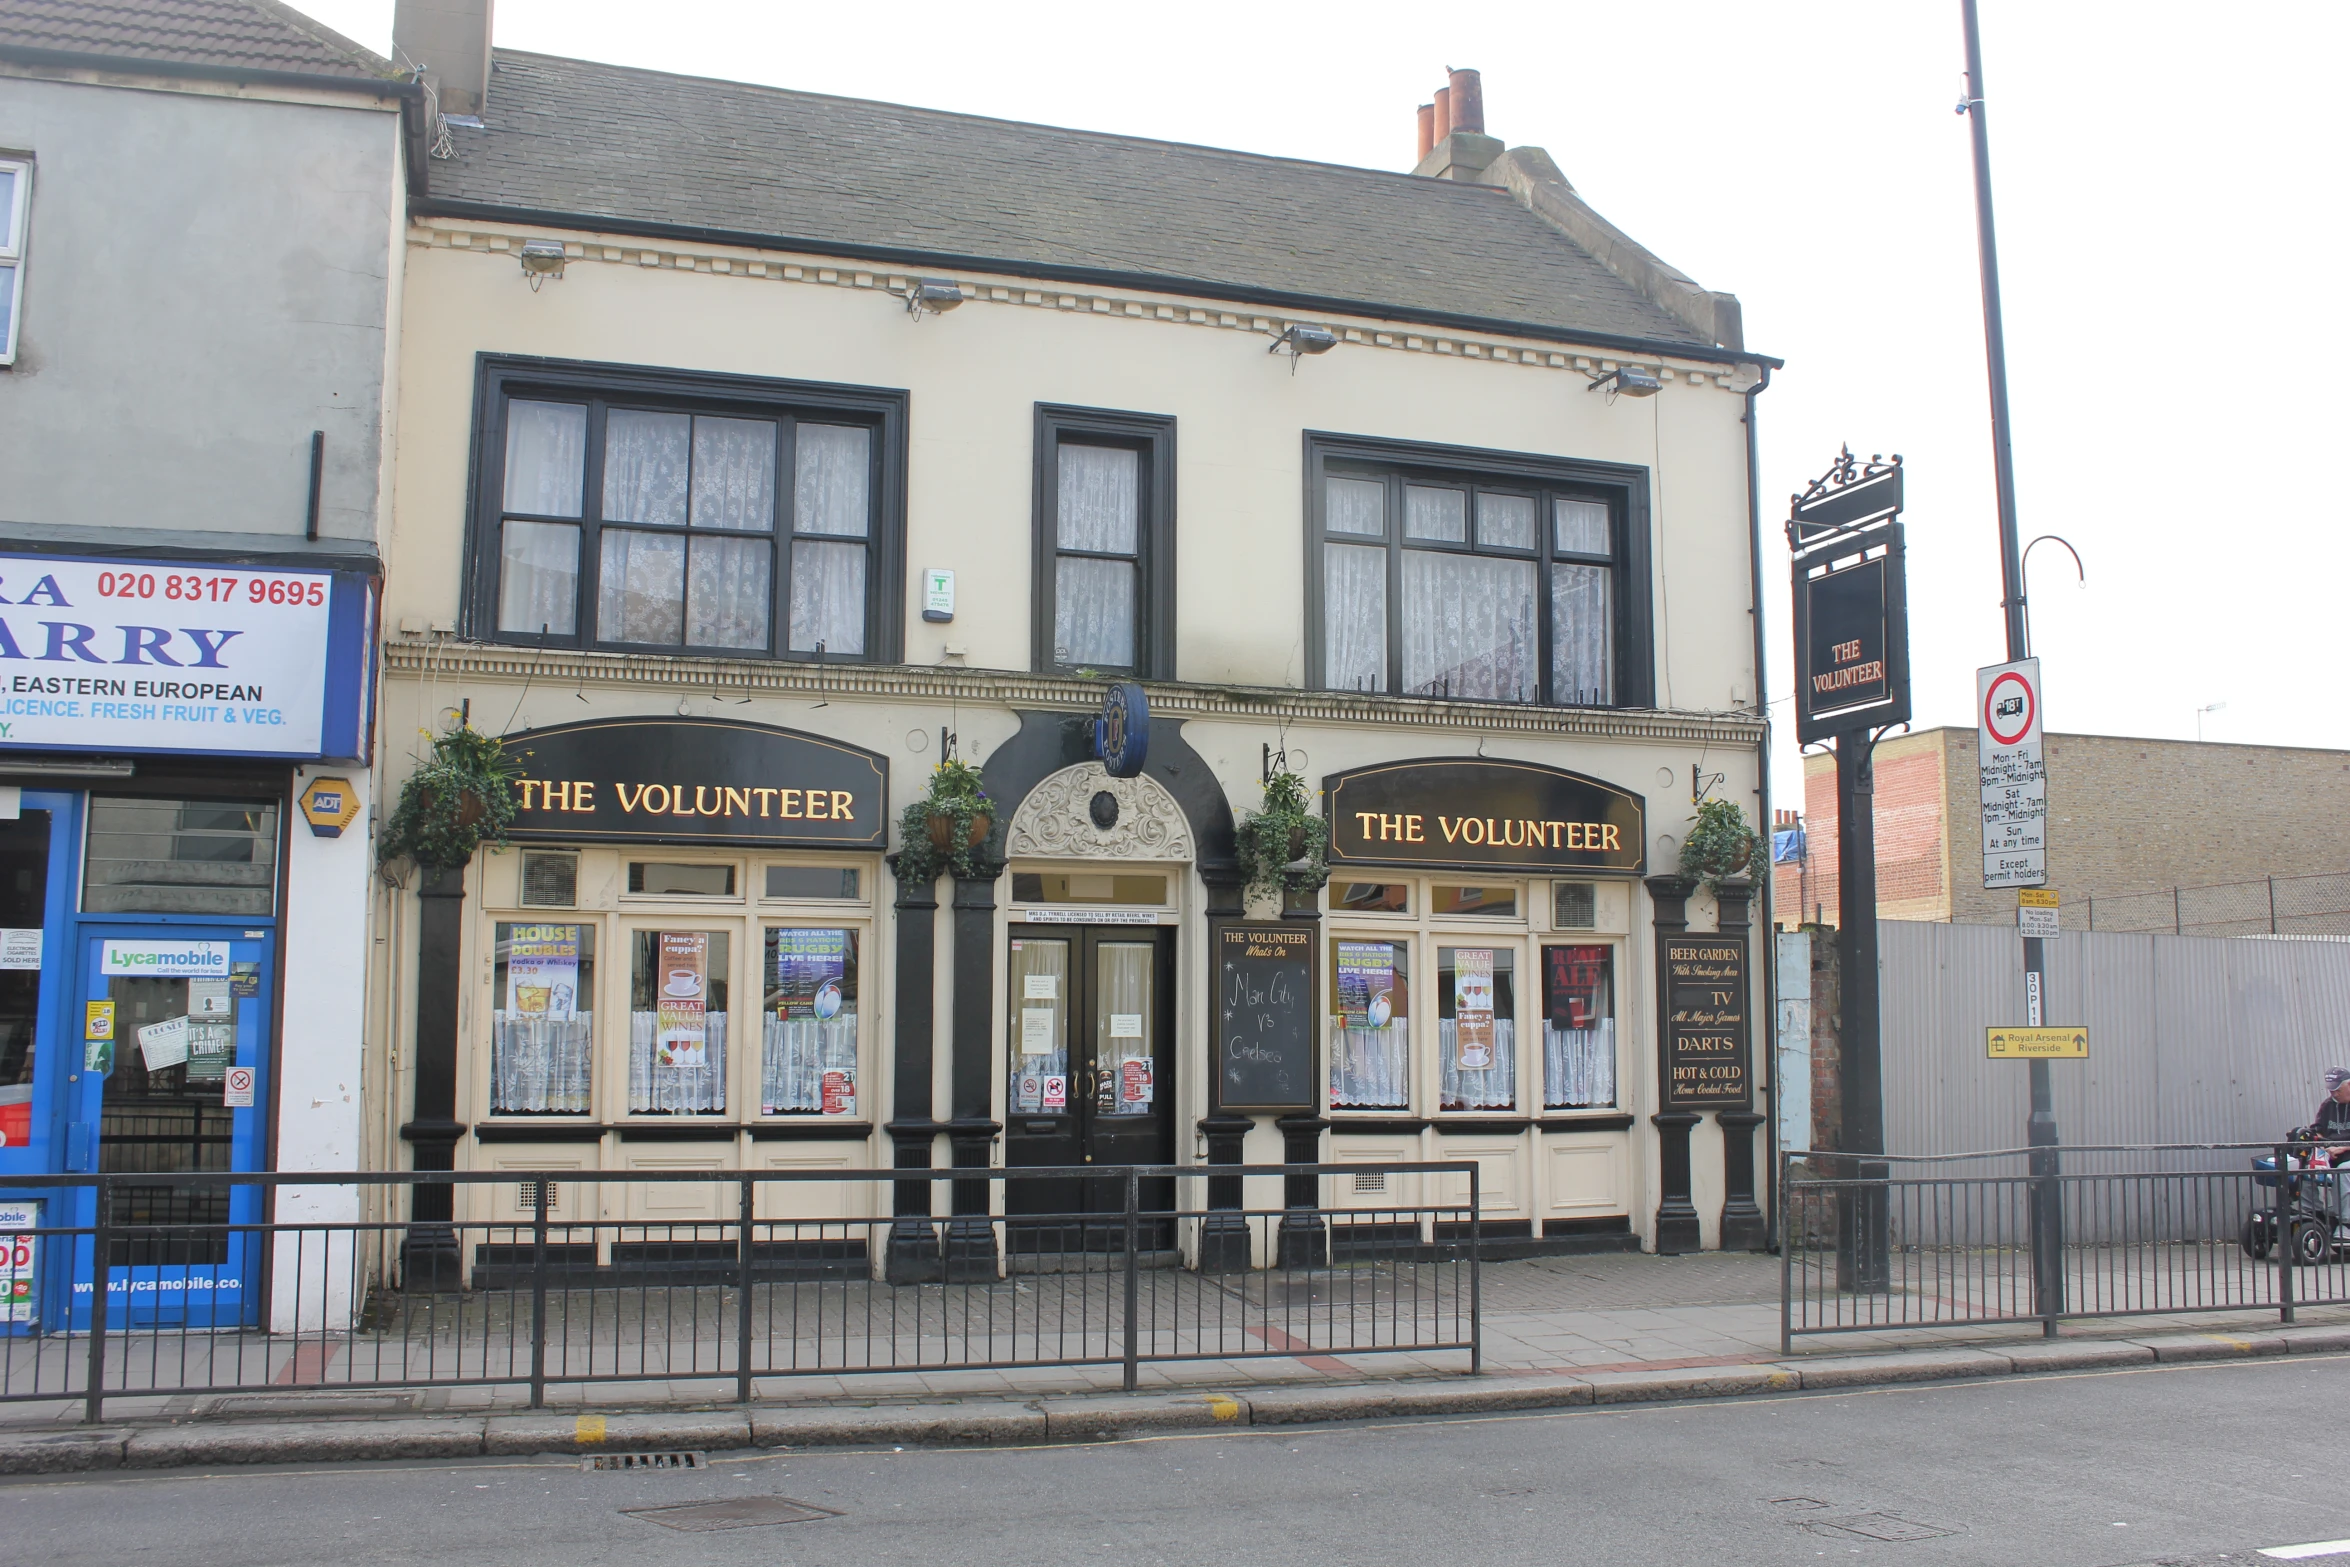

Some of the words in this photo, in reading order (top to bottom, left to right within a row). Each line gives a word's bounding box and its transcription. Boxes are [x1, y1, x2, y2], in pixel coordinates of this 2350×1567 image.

[98, 572, 155, 598] 020
[165, 574, 238, 603] 8317
[248, 578, 325, 607] 9695
[934, 578, 947, 591] T
[1831, 639, 1861, 664] THE
[1812, 660, 1883, 693] VOLUNTEER
[13, 676, 126, 697] EASTERN
[134, 680, 263, 702] EUROPEAN
[91, 702, 156, 720] FRESH
[163, 704, 218, 723] FRUIT
[223, 708, 237, 724] &
[243, 708, 287, 726] VEG.
[1993, 754, 2010, 764] Mon
[2018, 750, 2029, 760] Fri
[1981, 761, 2016, 777] Midnight
[2025, 760, 2042, 770] 7am
[1981, 776, 1999, 788] 9pm
[2007, 770, 2044, 783] Midnight
[515, 779, 596, 813] THE
[615, 782, 855, 821] VOLUNTEER
[2005, 789, 2020, 800] Sat
[313, 796, 342, 809] ADT
[1983, 800, 2018, 814] Midnight
[2026, 798, 2044, 808] 7am
[1984, 813, 2000, 824] 1pm
[2008, 808, 2044, 821] Midnight
[1356, 812, 1425, 843] THE
[1438, 816, 1621, 851] VOLUNTEER
[2006, 827, 2022, 837] Sun
[1990, 839, 1999, 849] At
[2003, 839, 2017, 849] any
[2021, 835, 2040, 846] time
[1999, 859, 2029, 871] Except
[1984, 871, 2011, 883] permit
[2015, 868, 2045, 880] holders
[512, 927, 577, 942] HOUSE
[664, 934, 696, 945] Fancy
[1224, 932, 1245, 943] THE
[1248, 933, 1308, 944] VOLUNTEER
[511, 944, 577, 957] DOUBLES
[665, 944, 703, 955] cuppa?
[779, 944, 843, 954] RUGBY
[1245, 944, 1273, 957] What's
[1274, 945, 1287, 957] On
[1456, 951, 1491, 960] GREAT
[1670, 947, 1698, 960] BEER
[1699, 948, 1739, 961] GARDEN
[111, 949, 224, 968] Lycamobile
[547, 959, 577, 967] Whiskey
[778, 954, 804, 962] LIVE
[1339, 958, 1393, 967] RUGBY
[1551, 949, 1601, 965] REAL
[511, 966, 539, 975] £3.30
[1457, 960, 1491, 970] VALUE
[1362, 968, 1393, 976] HERE!
[1458, 969, 1491, 979] WINES
[1552, 965, 1600, 986] ALE
[1672, 964, 1690, 976] With
[1691, 964, 1721, 980] Smoking
[1721, 965, 1738, 977] Area
[1711, 991, 1734, 1005] TV
[660, 1001, 704, 1011] GREAT
[661, 1011, 703, 1021] VALUE
[1458, 1012, 1485, 1022] Fancy
[1671, 1010, 1687, 1022] All
[1687, 1010, 1714, 1026] Major
[1714, 1010, 1741, 1025] Games
[661, 1021, 703, 1032] WINES
[1460, 1020, 1490, 1030] cuppa?
[189, 1027, 206, 1041] IT'S
[207, 1026, 214, 1039] A
[2008, 1033, 2033, 1043] Royal
[2036, 1033, 2070, 1042] Arsenal
[192, 1038, 225, 1056] CRIME!
[1677, 1036, 1734, 1051] DARTS
[2018, 1044, 2061, 1052] Riverside
[1141, 1061, 1151, 1070] 21
[843, 1072, 855, 1082] 21
[1673, 1066, 1698, 1080] HOT
[1699, 1067, 1708, 1080] &
[1709, 1066, 1741, 1080] COLD
[841, 1085, 851, 1093] 18
[1673, 1083, 1695, 1095] Home
[1697, 1082, 1721, 1095] Cooked
[1722, 1082, 1742, 1095] Food
